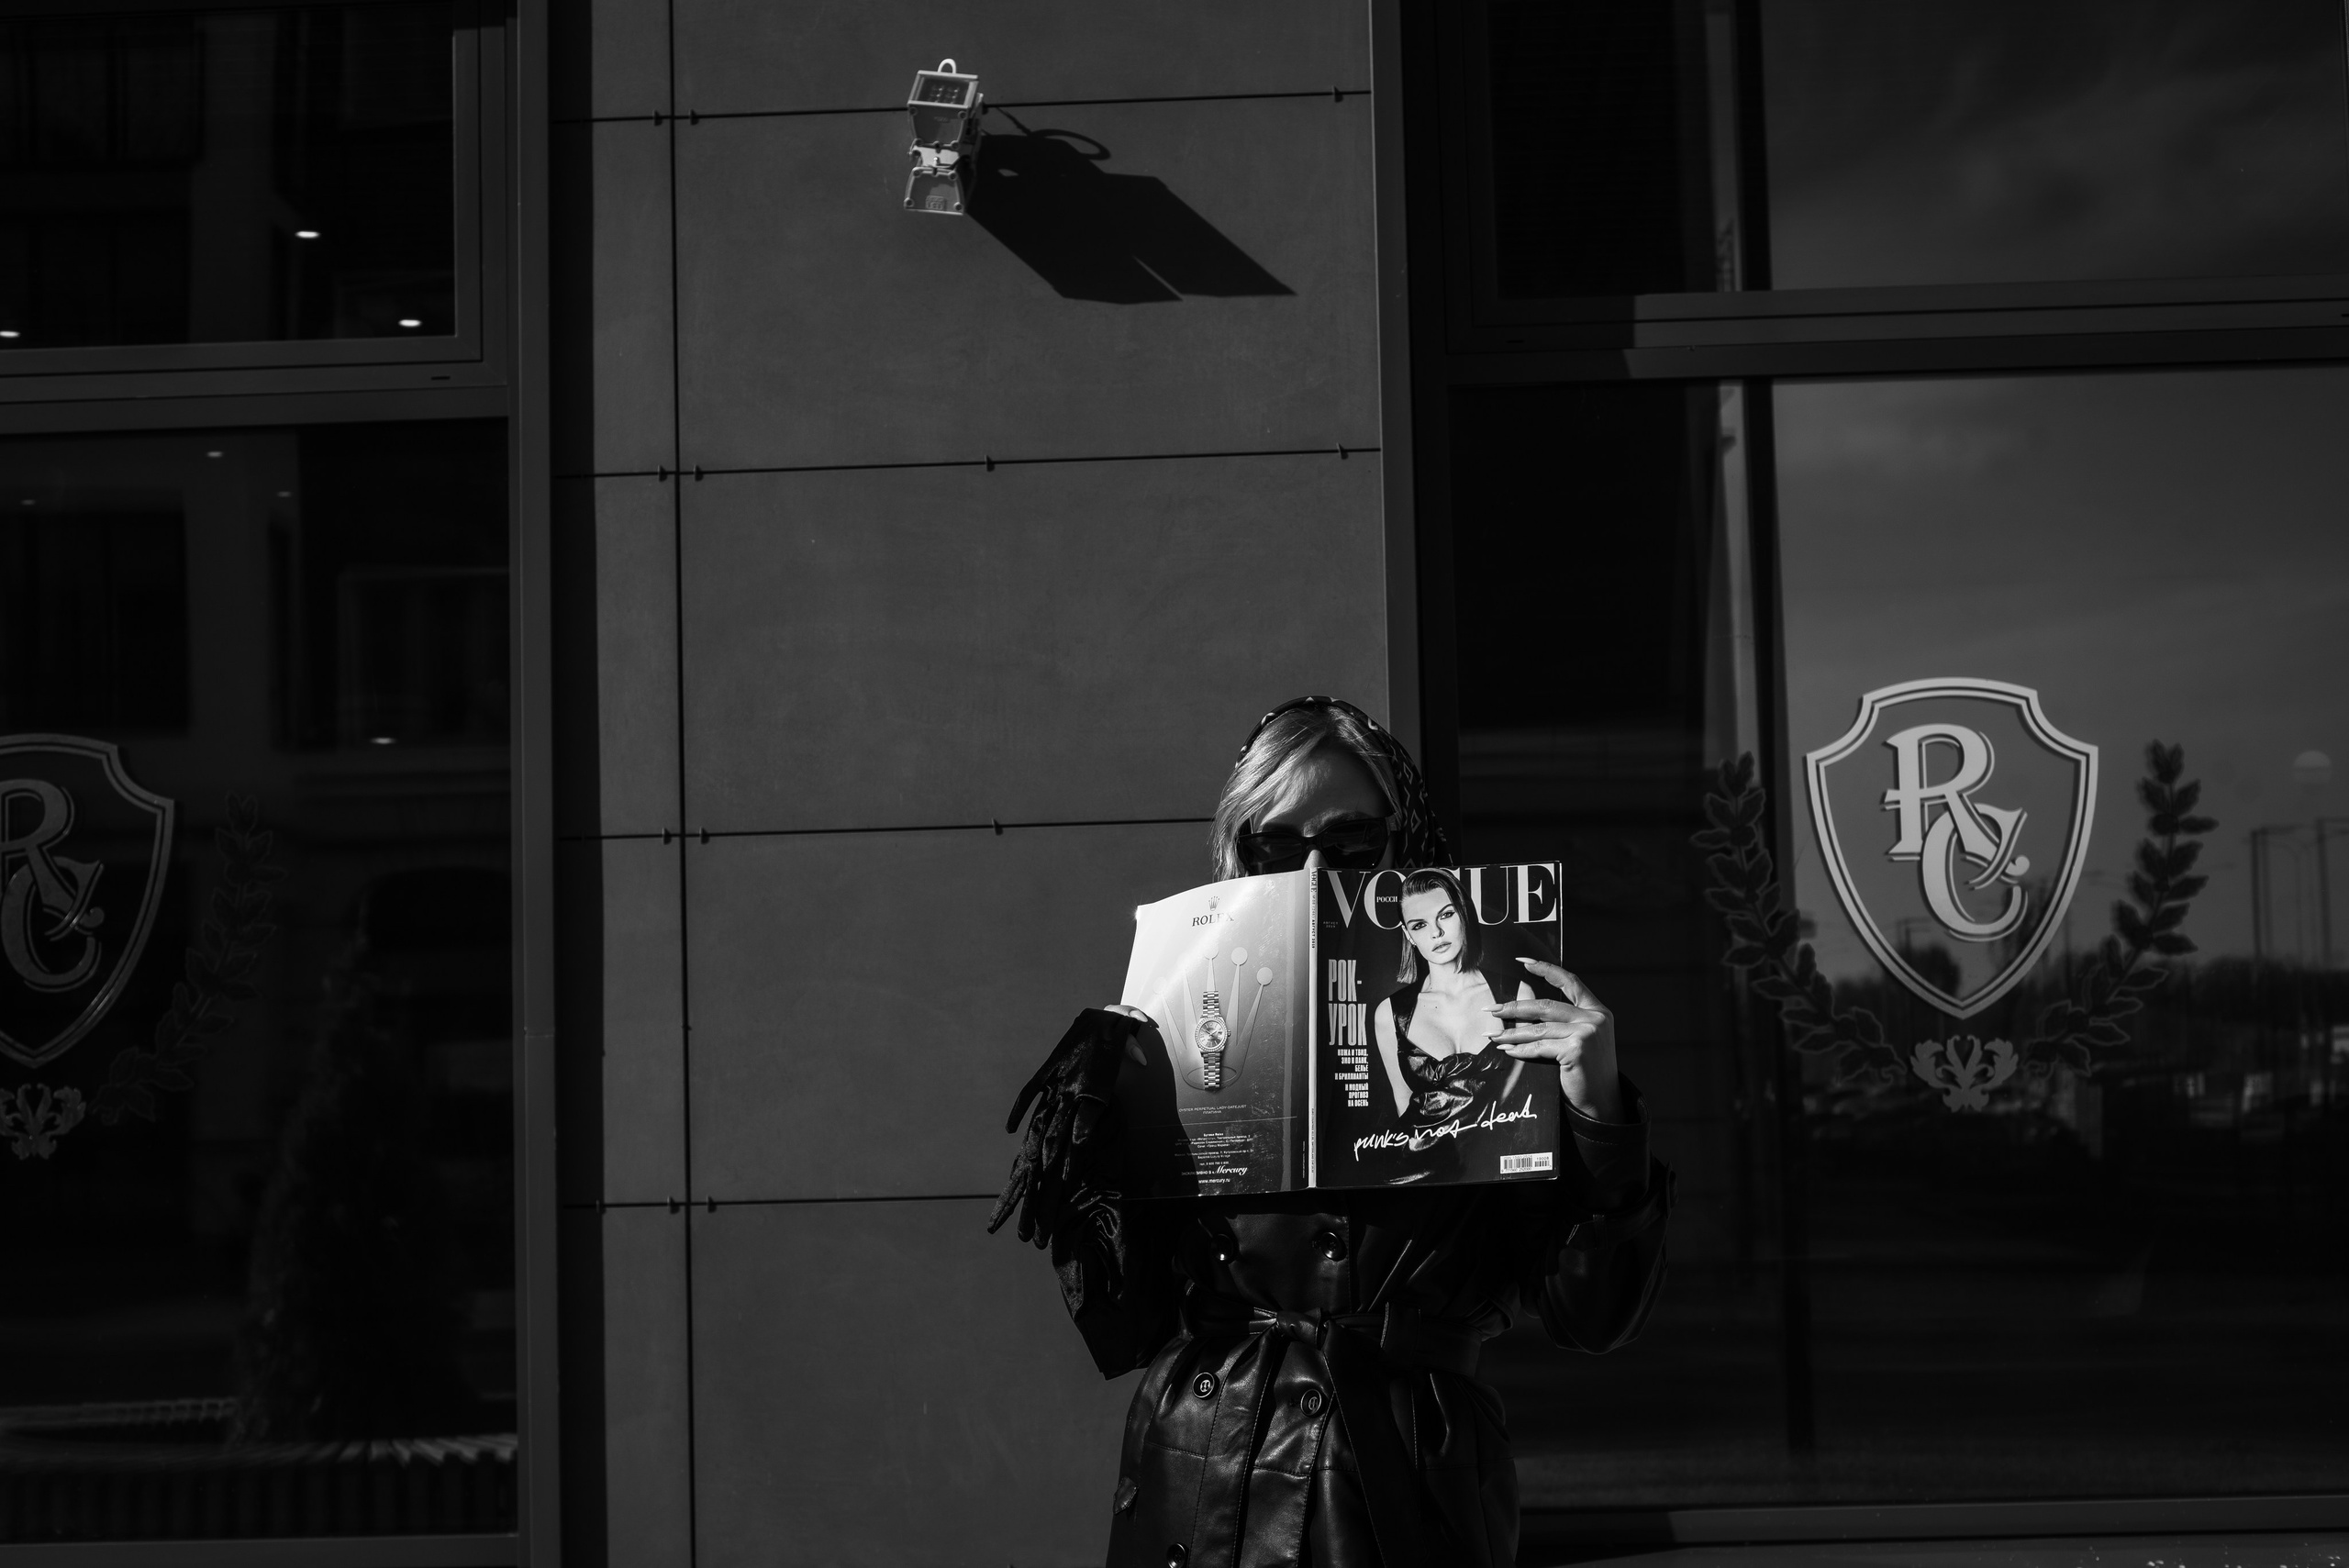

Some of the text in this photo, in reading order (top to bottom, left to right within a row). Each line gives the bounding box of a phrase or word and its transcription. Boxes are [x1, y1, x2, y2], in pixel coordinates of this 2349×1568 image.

[1321, 863, 1557, 929] VOUE
[1329, 959, 1362, 1002] РОК-
[1329, 1003, 1367, 1046] УРОК
[1480, 1094, 1538, 1131] dead
[1212, 1165, 1248, 1175] Mercury
